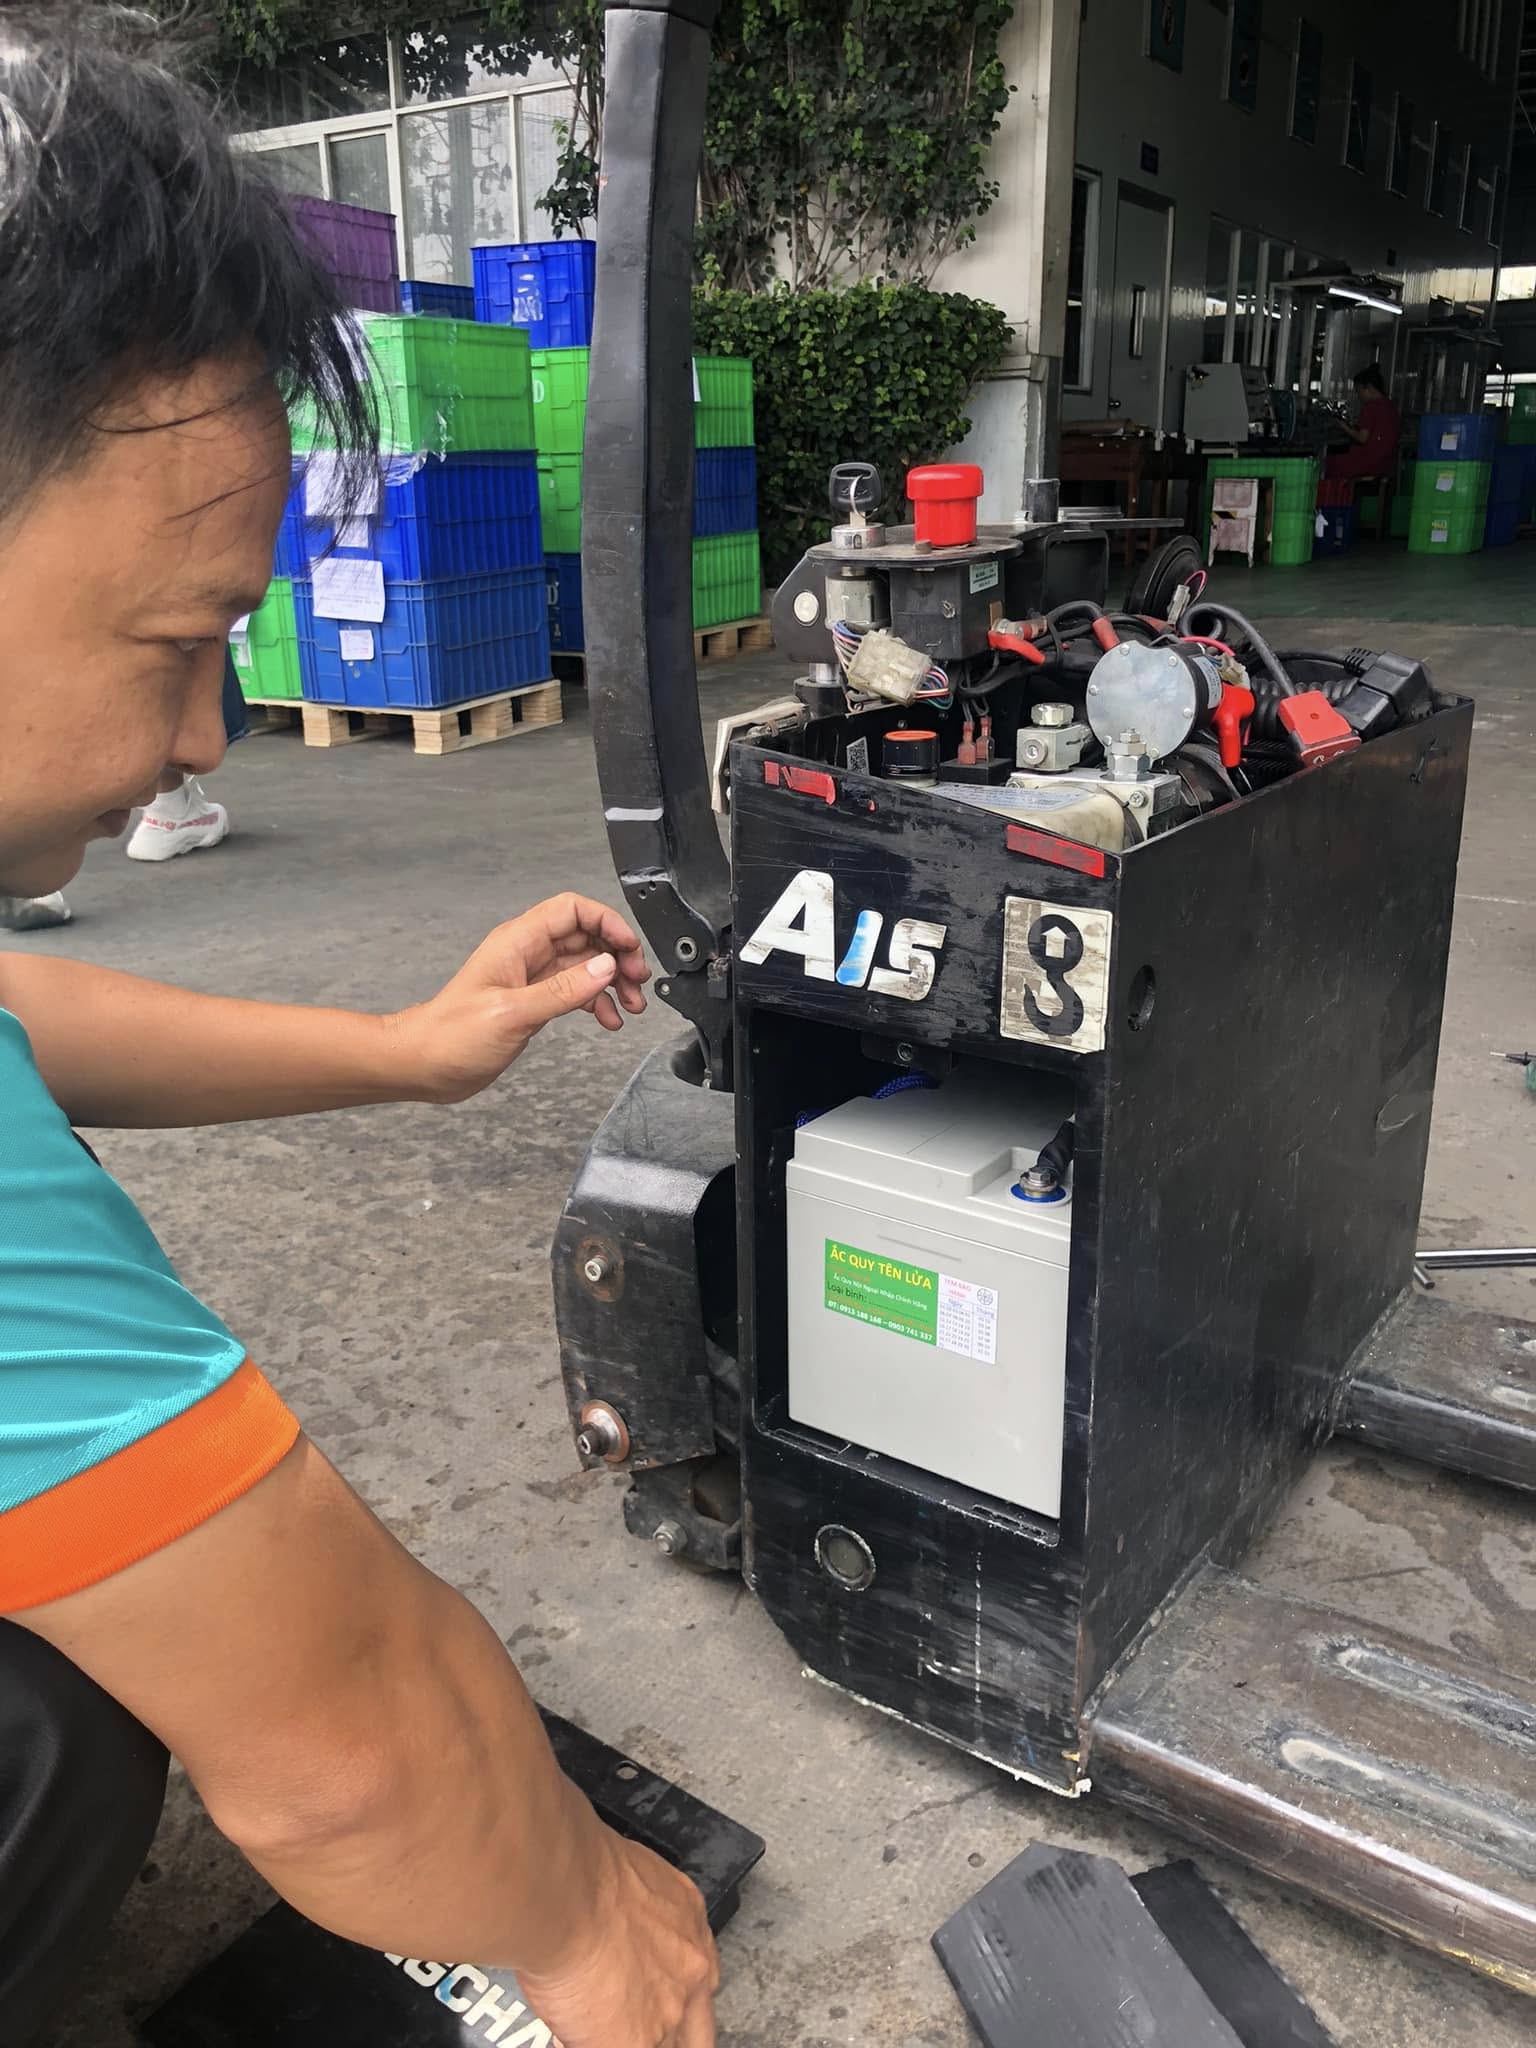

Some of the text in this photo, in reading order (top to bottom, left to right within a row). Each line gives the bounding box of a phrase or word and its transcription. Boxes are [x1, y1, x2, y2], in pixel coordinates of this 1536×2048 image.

[848, 1254, 875, 1272] QUY
[878, 1263, 902, 1281] TÊN
[905, 1269, 932, 1290] LỬA
